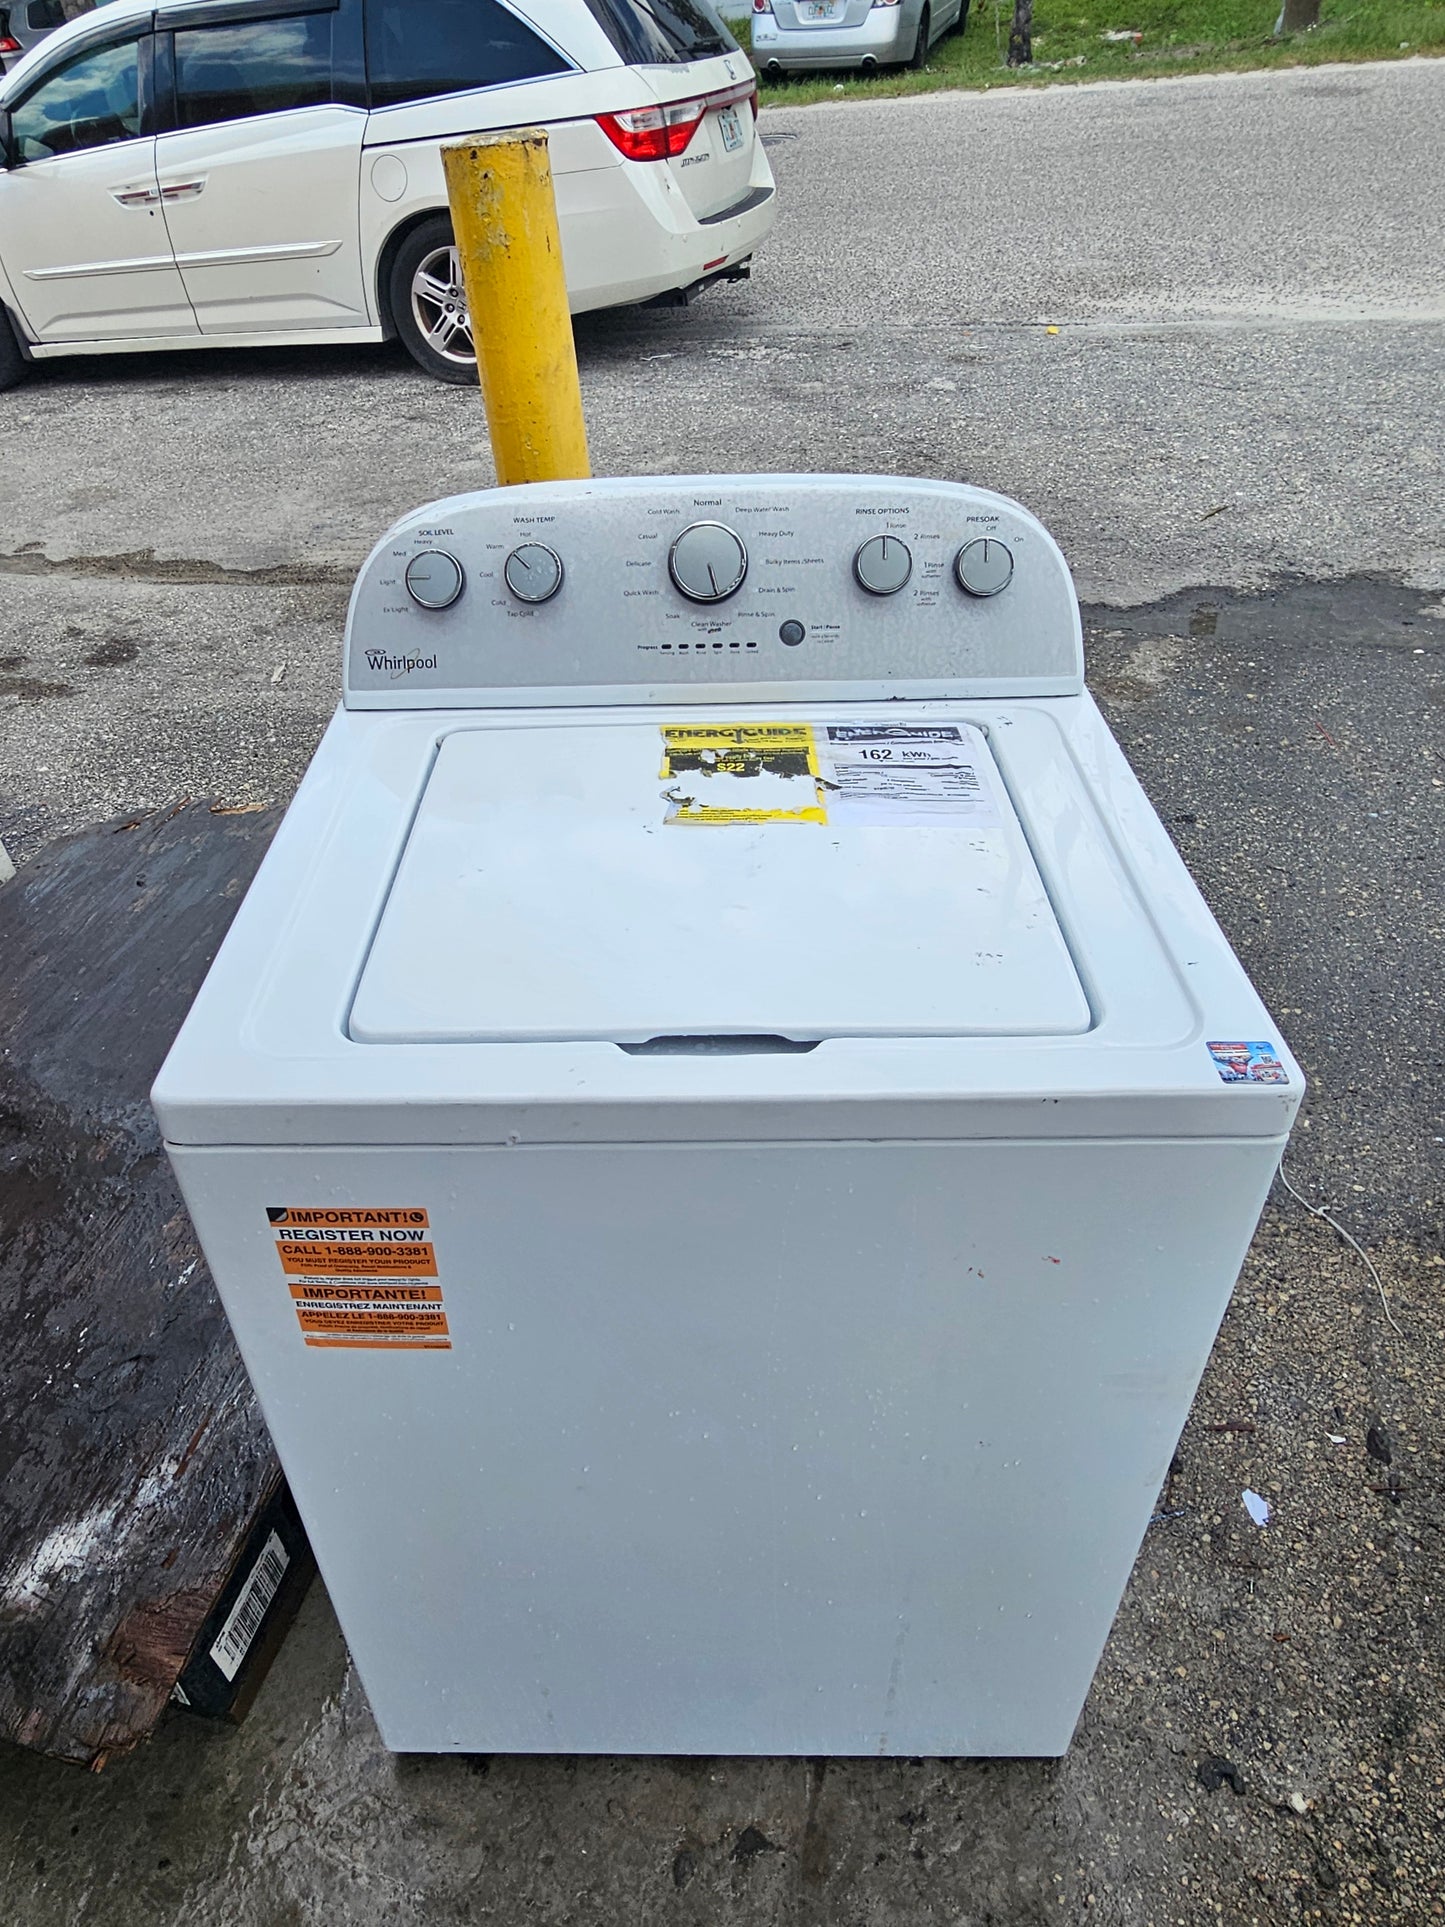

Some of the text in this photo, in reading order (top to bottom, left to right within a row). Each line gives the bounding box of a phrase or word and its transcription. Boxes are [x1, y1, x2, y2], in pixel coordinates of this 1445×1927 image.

[877, 507, 910, 515] OPTIONS
[418, 528, 455, 537] SOIL LEVEL
[366, 653, 438, 675] Whirlpool
[665, 727, 807, 741] ENERGYGUIDE
[858, 748, 893, 760] 162
[290, 1211, 408, 1223] IMPORTANT!
[279, 1229, 425, 1241] REGISTER NOW
[282, 1245, 429, 1257] CALL 1-888-900-3381
[303, 1288, 426, 1300] IMPORTANTE!
[296, 1301, 442, 1311] ENREGISTREZ MAINTENANT
[302, 1311, 441, 1321] APPELEZ LE 1-888-900-3381
